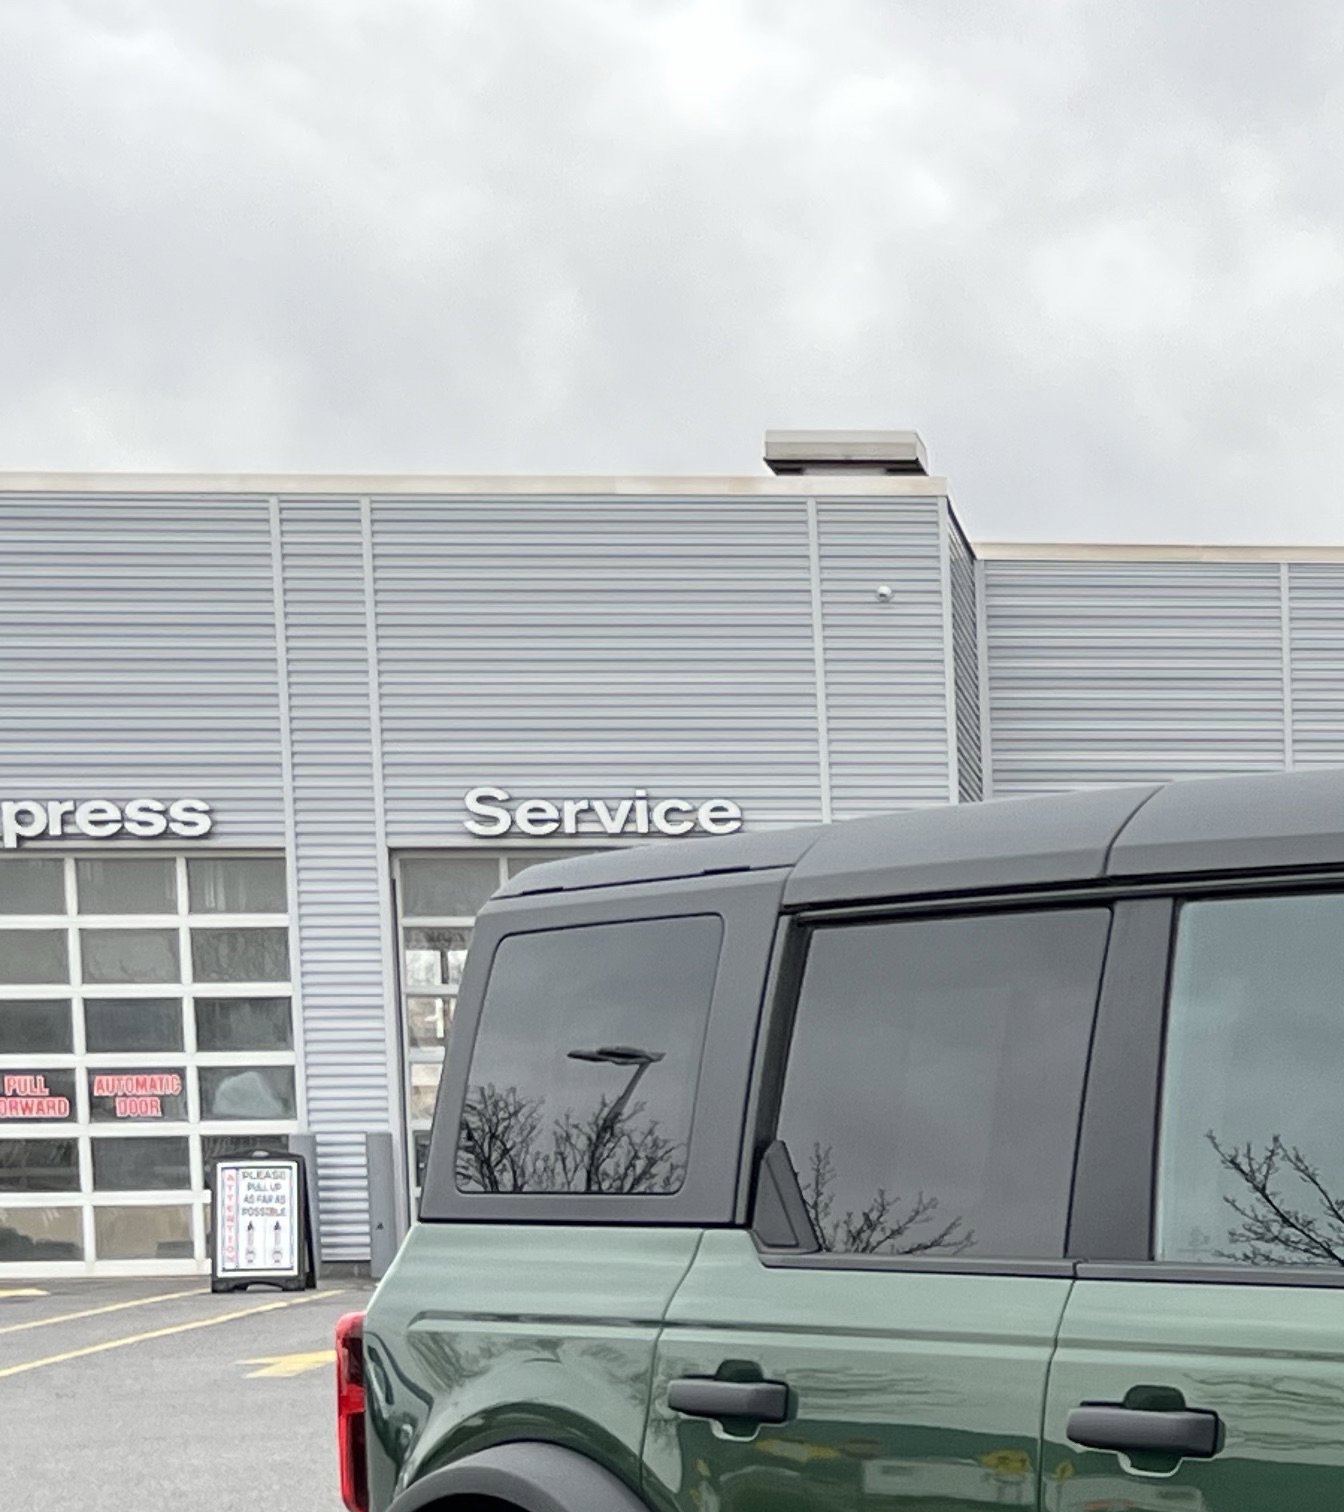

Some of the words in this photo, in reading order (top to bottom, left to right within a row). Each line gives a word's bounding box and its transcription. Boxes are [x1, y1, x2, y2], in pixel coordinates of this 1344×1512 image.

[464, 786, 742, 837] Service
[5, 1075, 49, 1096] PULL
[94, 1074, 182, 1096] AUTOMATIC
[116, 1097, 162, 1118] DOOR
